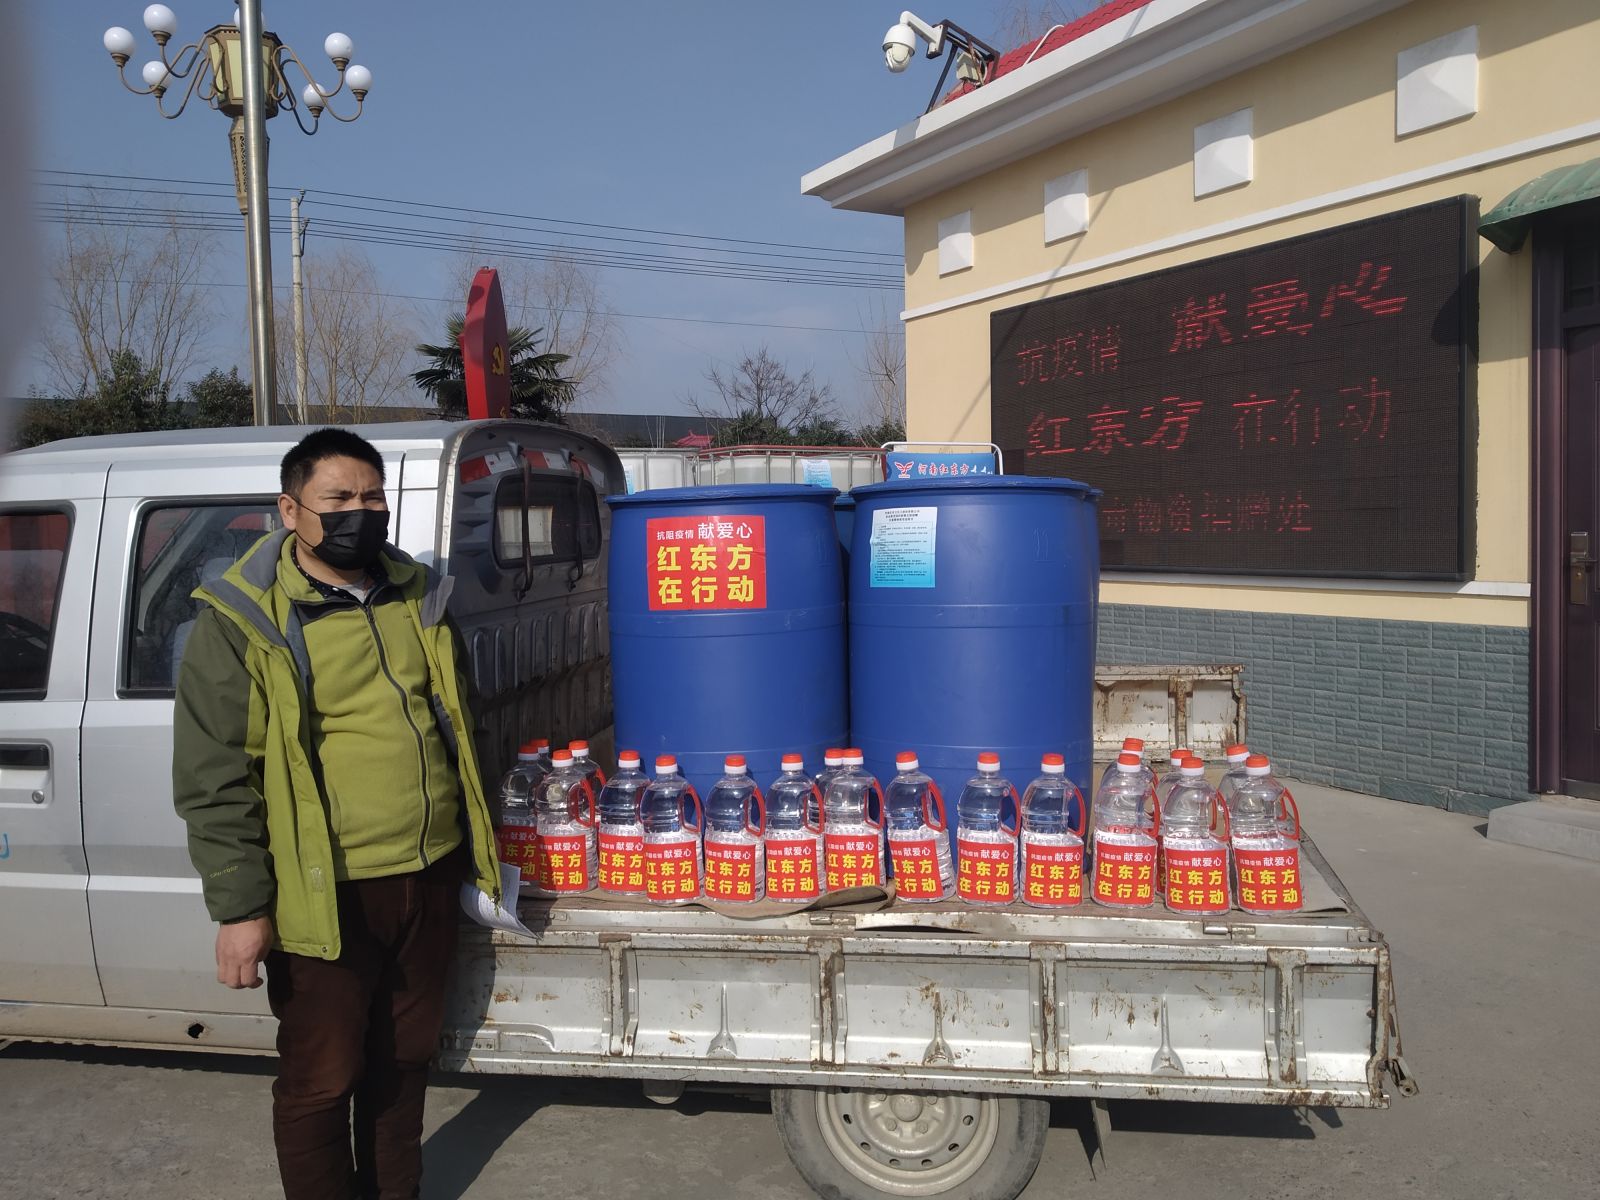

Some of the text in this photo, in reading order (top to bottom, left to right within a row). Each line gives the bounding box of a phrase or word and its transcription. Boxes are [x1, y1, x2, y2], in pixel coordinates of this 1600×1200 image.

[1168, 262, 1408, 353] 献爱心
[656, 522, 753, 541] 抗阻疫情 献爱心
[657, 544, 754, 572] 红东方
[658, 576, 755, 605] 在行动
[553, 841, 581, 851] 献爱心
[616, 842, 643, 851] 献爱心
[664, 848, 692, 859] 献爱心
[784, 846, 812, 856] 献爱心
[846, 841, 874, 851] 献爱心
[903, 846, 931, 856] 献爱心
[600, 851, 643, 868] 红东方
[724, 850, 751, 860] 献爱心
[828, 853, 875, 869] 红东方
[980, 849, 1010, 860] 献爱心
[1054, 852, 1081, 862] 献爱心
[1123, 852, 1152, 862] 献爱心
[1191, 857, 1222, 867] 献爱心
[1263, 856, 1295, 867] 献爱心
[646, 861, 692, 876] 红东方
[706, 859, 751, 877] 红东方
[768, 859, 812, 874] 红东方
[960, 859, 1010, 877] 红东方
[1030, 863, 1081, 880] 红东方
[1100, 861, 1152, 880] 红东方
[599, 869, 643, 885] 在行动
[768, 877, 814, 892] 在行动
[828, 871, 875, 886] 在行动
[1169, 868, 1223, 886] 红东方
[1241, 868, 1296, 886] 红东方
[647, 878, 695, 893] 在行动
[705, 877, 751, 894] 在行动
[959, 877, 1010, 896] 在行动
[1029, 881, 1081, 898] 在行动
[1098, 880, 1151, 898] 在行动
[1170, 888, 1224, 905] 在行动
[1242, 888, 1298, 905] 在行动
